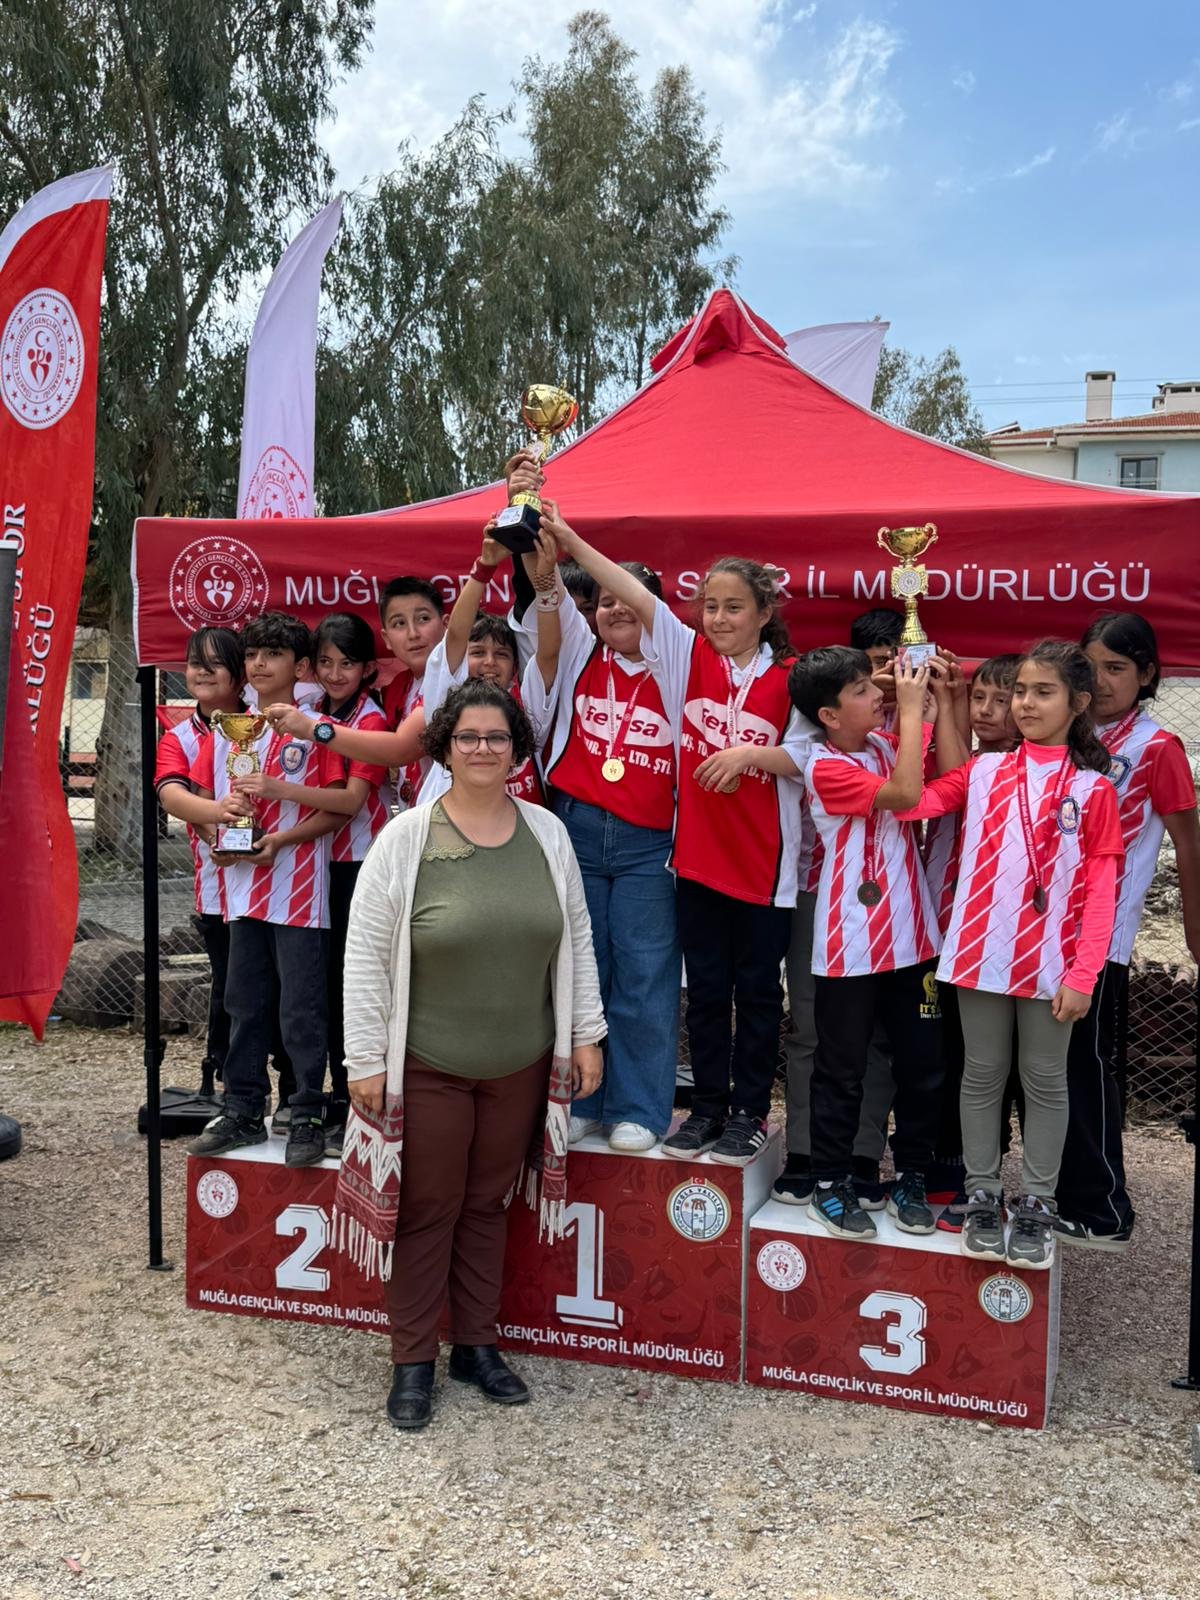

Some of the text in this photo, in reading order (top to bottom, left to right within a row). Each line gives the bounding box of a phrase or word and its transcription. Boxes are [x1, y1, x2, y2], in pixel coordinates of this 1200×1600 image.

[285, 569, 380, 606] MUĞL
[807, 564, 840, 599] İL
[853, 561, 1150, 602] MDÜRLÜĞÜ
[629, 749, 651, 768] LTD.
[675, 1187, 693, 1211] MUĞLA
[275, 1203, 331, 1292] 2
[555, 1201, 624, 1330] 1
[200, 1288, 391, 1326] MUĞLA GENÇLİK VE SPOR İL MÜDÜR
[504, 1324, 560, 1346] GENÇLİK
[560, 1331, 578, 1348] VE
[579, 1335, 616, 1353] SPOR
[619, 1337, 631, 1355] İL
[633, 1341, 725, 1368] MÜDÜRLÜĞÜ
[859, 1289, 928, 1375] 3
[762, 1365, 1029, 1418] MUĞLA GENÇLİK VE SPOR İL MÜDÜRLÜĞÜ
